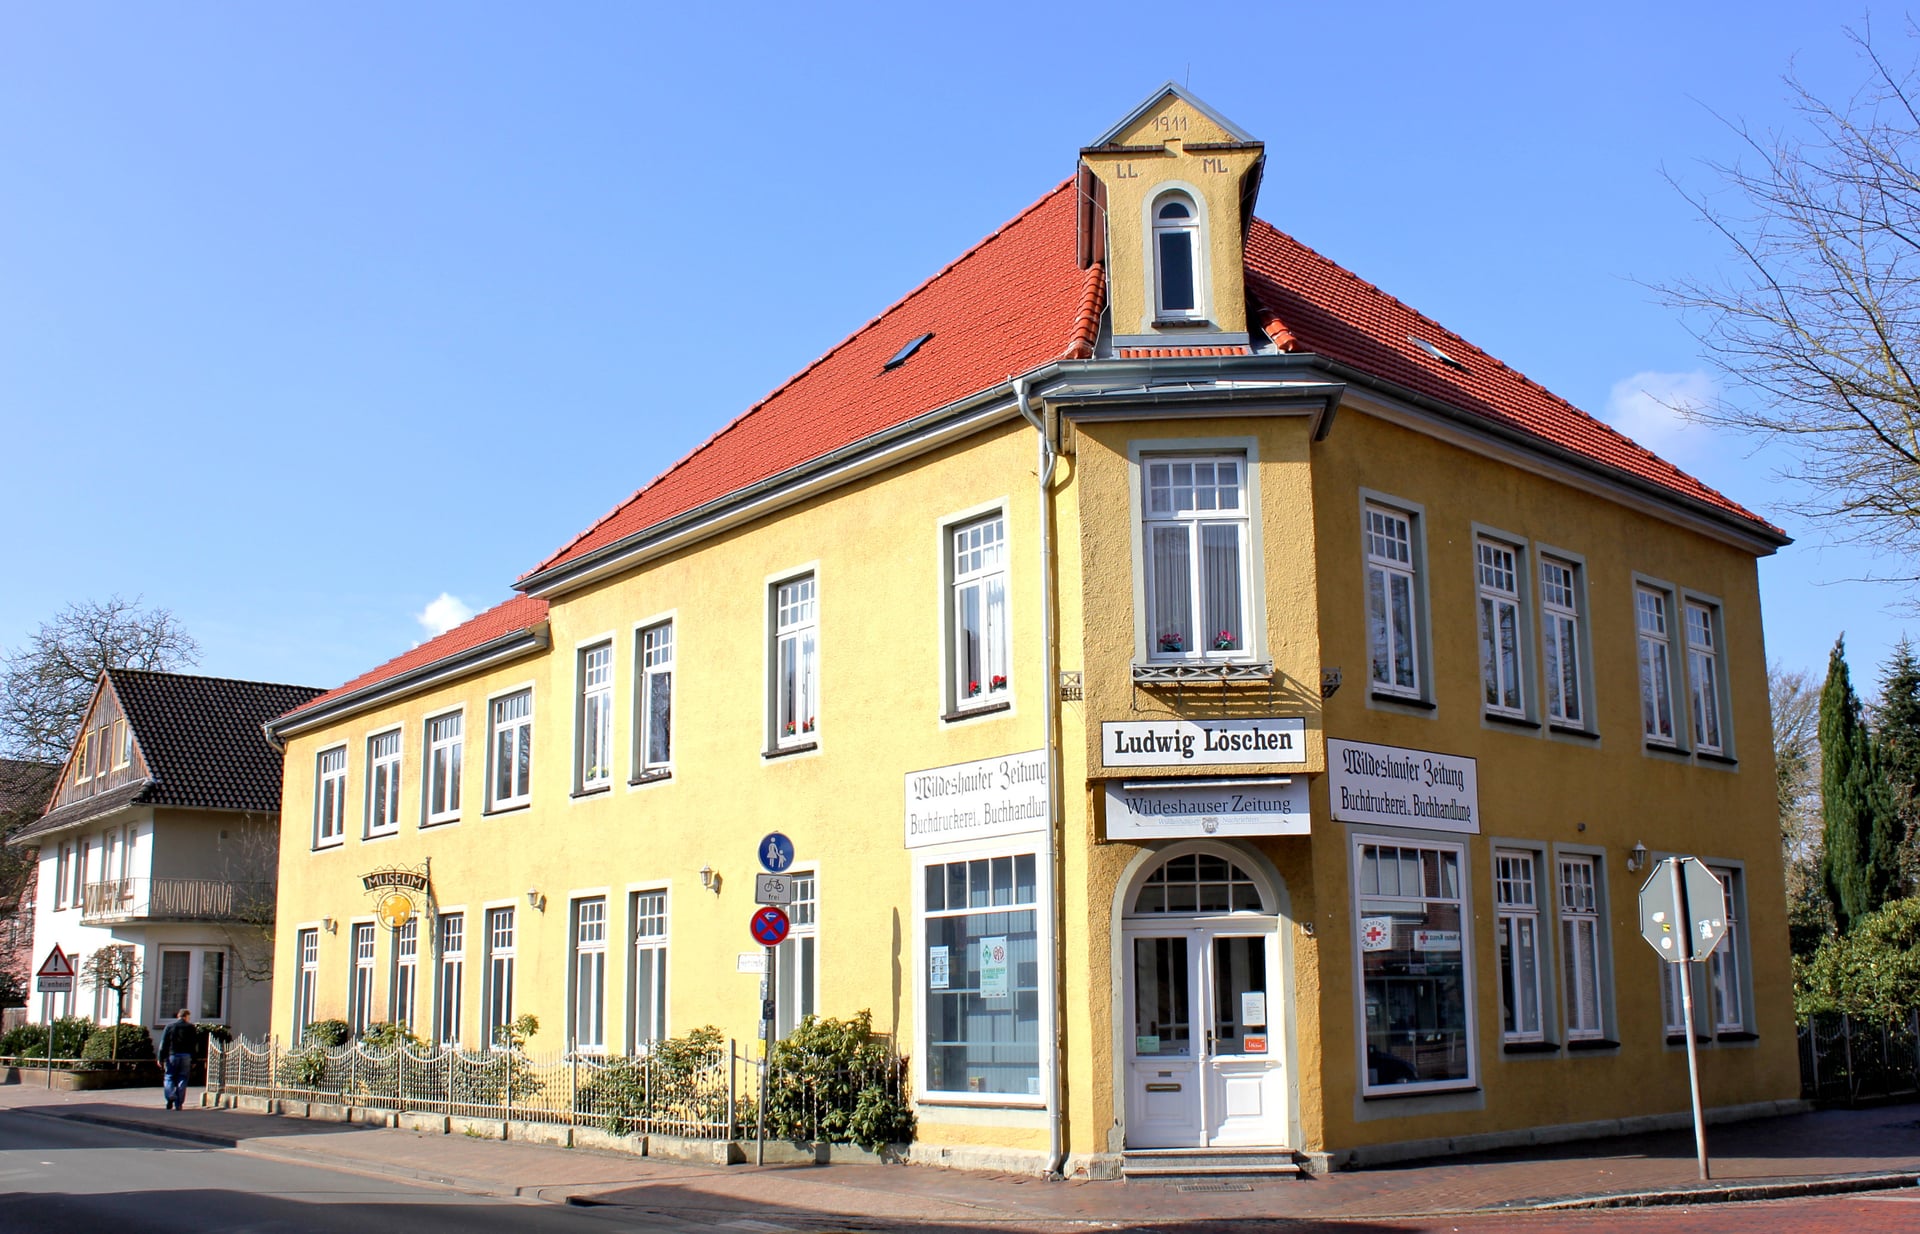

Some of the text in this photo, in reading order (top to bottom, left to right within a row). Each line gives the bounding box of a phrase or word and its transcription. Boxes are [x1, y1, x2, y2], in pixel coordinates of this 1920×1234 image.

[1151, 116, 1187, 131] 1911
[1116, 163, 1138, 179] LL
[1203, 159, 1229, 174] ML
[1114, 727, 1293, 759] Ludwig Löschen
[1424, 758, 1465, 792] Zeitung
[1125, 795, 1292, 815] Wildeshauser Zeitung
[1340, 786, 1407, 816] Buchdruckerei
[1413, 793, 1471, 823] Buchhandlung
[910, 808, 977, 835] Buchdruckerei
[984, 795, 1047, 825] Buchhandlun
[367, 873, 423, 888] MUSEUM
[768, 893, 780, 901] frei
